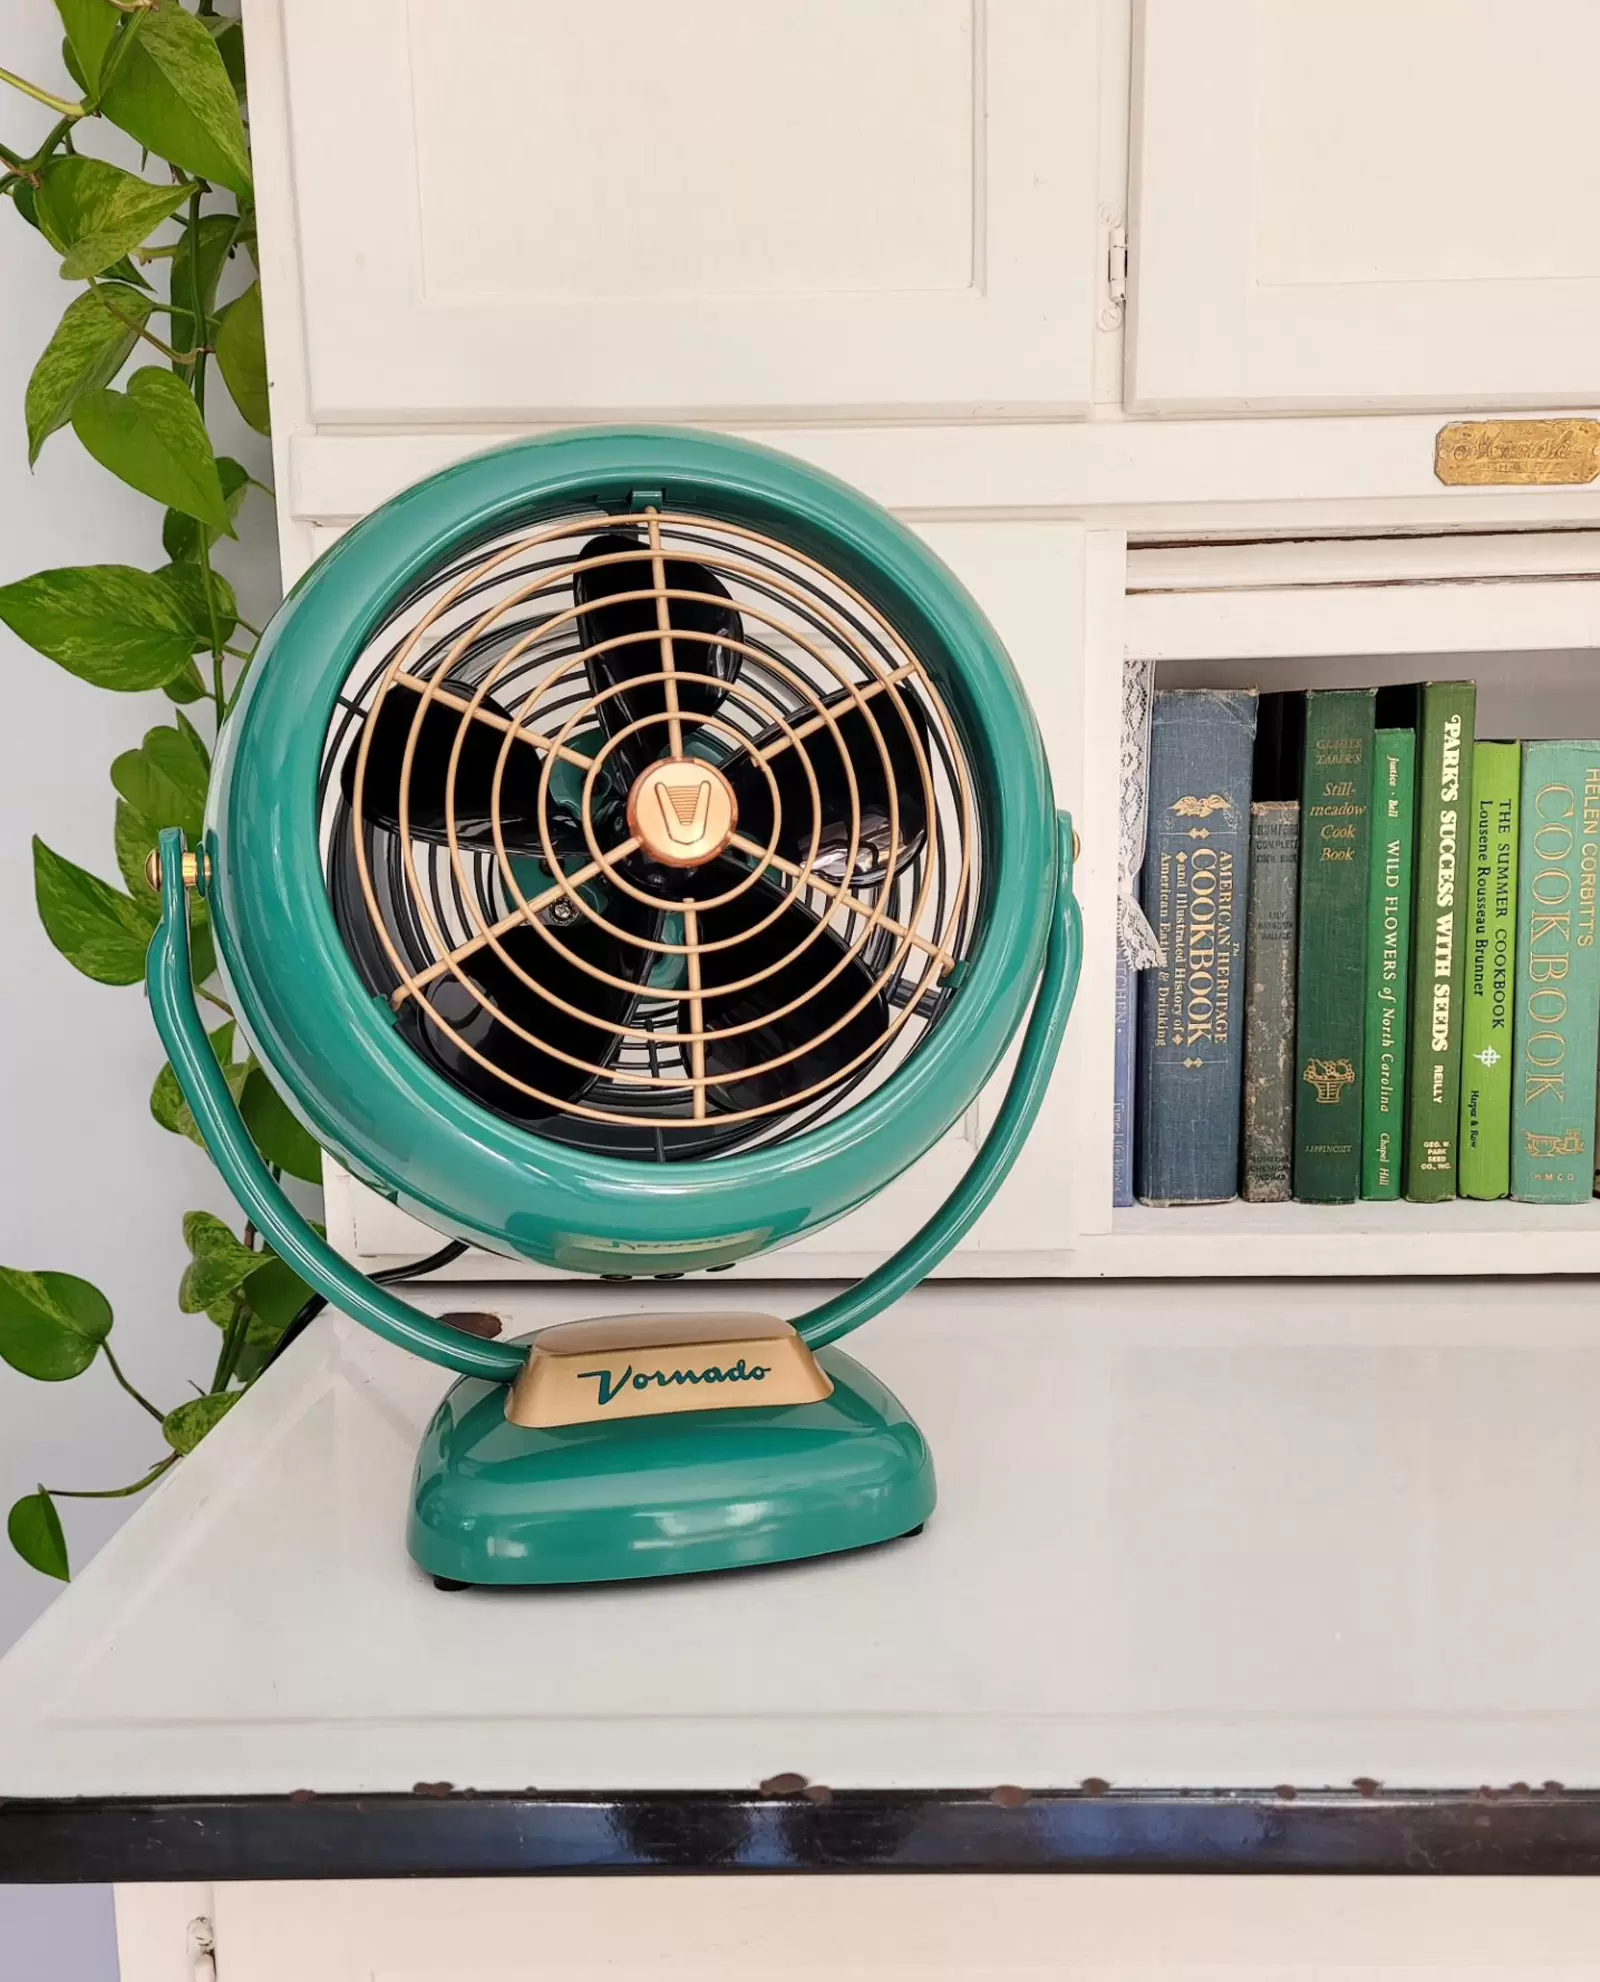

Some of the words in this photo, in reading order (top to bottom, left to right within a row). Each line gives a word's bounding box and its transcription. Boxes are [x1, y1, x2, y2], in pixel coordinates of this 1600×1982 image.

[1387, 755, 1400, 786] Justice
[1441, 714, 1461, 802] PARK'S
[1309, 802, 1367, 816] meadow
[1323, 781, 1356, 797] Still-
[1388, 800, 1399, 817] Bell
[1498, 799, 1512, 833] THE
[1583, 768, 1600, 834] HELEN
[1320, 847, 1355, 861] Book
[1321, 824, 1357, 840] Cook
[1437, 810, 1457, 907] SUCCESS
[1478, 800, 1493, 861] Lousene
[1159, 852, 1171, 918] American
[1176, 864, 1187, 888] and
[1386, 840, 1400, 888] WILD
[1496, 843, 1510, 918] SUMMER
[1218, 851, 1233, 945] AMERICAN
[1476, 866, 1491, 934] Rousseau
[1577, 842, 1598, 946] CORBITT'S
[1175, 893, 1188, 962] Illustrated
[1187, 848, 1218, 1047] COOKBOOK
[1232, 942, 1240, 957] The
[1383, 896, 1399, 980] FLOWERS
[1435, 911, 1453, 978] WITH
[1525, 783, 1577, 1106] COOKBOOK
[1158, 971, 1169, 981] &
[1172, 968, 1186, 1018] History
[1378, 986, 1396, 1003] of
[1474, 939, 1489, 997] Brunner
[1492, 928, 1507, 1029] COOKBOOK
[1155, 987, 1170, 1047] Drinking
[1173, 1020, 1184, 1033] of
[1214, 952, 1230, 1043] HERITAGE
[1432, 984, 1450, 1052] SEEDS
[1381, 1007, 1396, 1047] North
[1380, 1053, 1394, 1112] Carolina
[1432, 1064, 1444, 1104] REILLY
[1376, 1133, 1390, 1163] Chapel
[1379, 1167, 1390, 1186] Hill
[577, 1359, 771, 1405] Vornado
